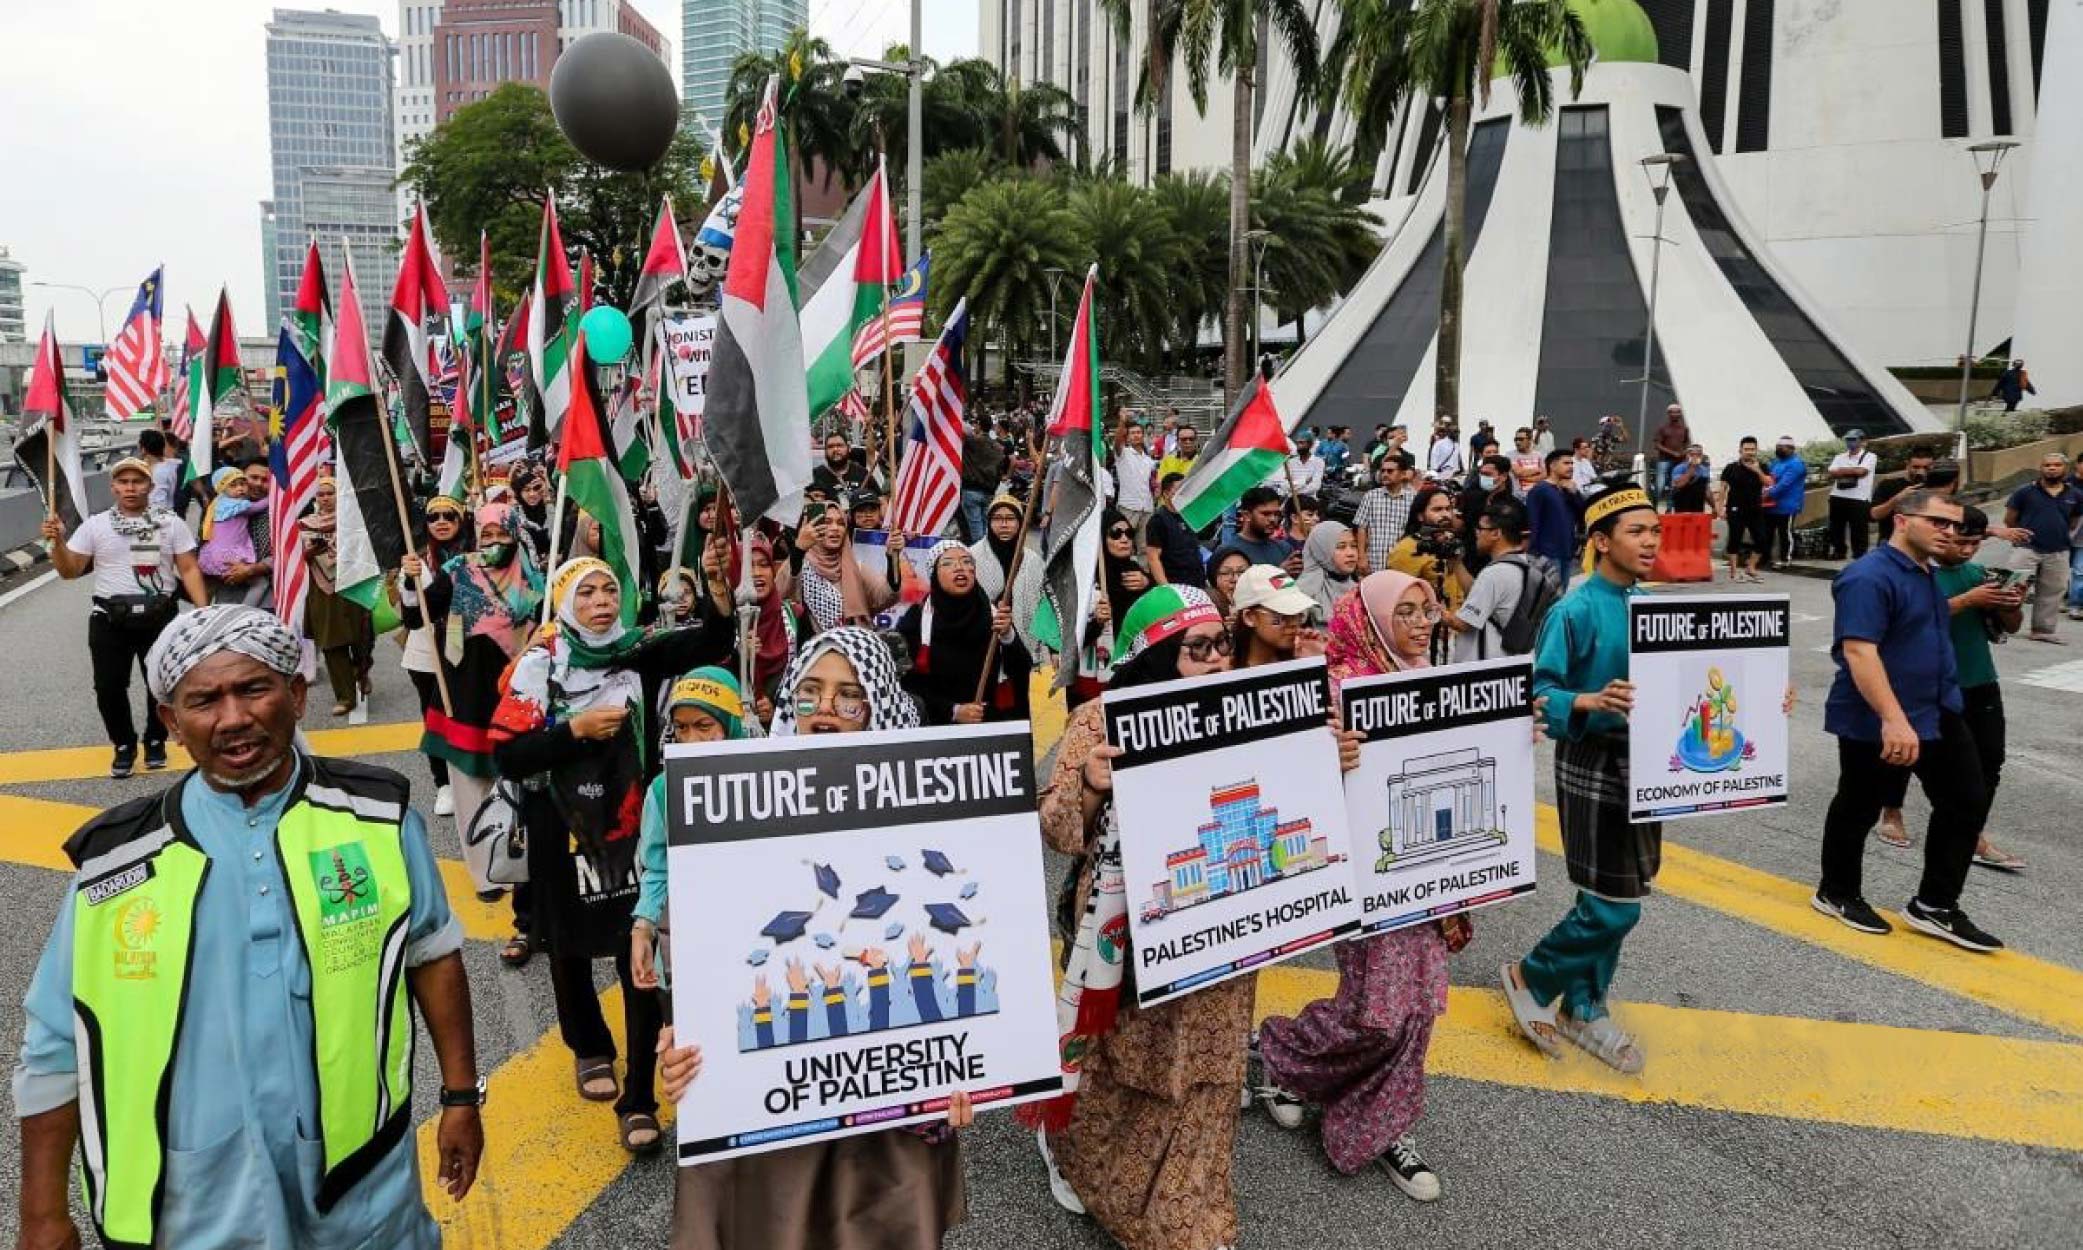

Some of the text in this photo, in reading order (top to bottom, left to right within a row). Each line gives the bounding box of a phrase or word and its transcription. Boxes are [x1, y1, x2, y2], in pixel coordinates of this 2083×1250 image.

[1637, 610, 1784, 643] FUTURE OF PALESTINE
[1115, 680, 1325, 752] FUTURE OF PALESTINE
[1351, 675, 1527, 731] FUTURE OF PALESTINE
[683, 751, 1025, 826] FUTURE OF PALESTINE
[1636, 773, 1784, 803] ECONOMY OF PALESTINE
[1363, 860, 1520, 913] BANK OF PALESTINE
[322, 902, 378, 927] MAPIM
[1142, 885, 1353, 968] PALESTINE'S HOSPITAL
[764, 1083, 810, 1114] OF
[819, 1053, 985, 1106] PALESTINE
[785, 1032, 968, 1085] UNIVERSITY
